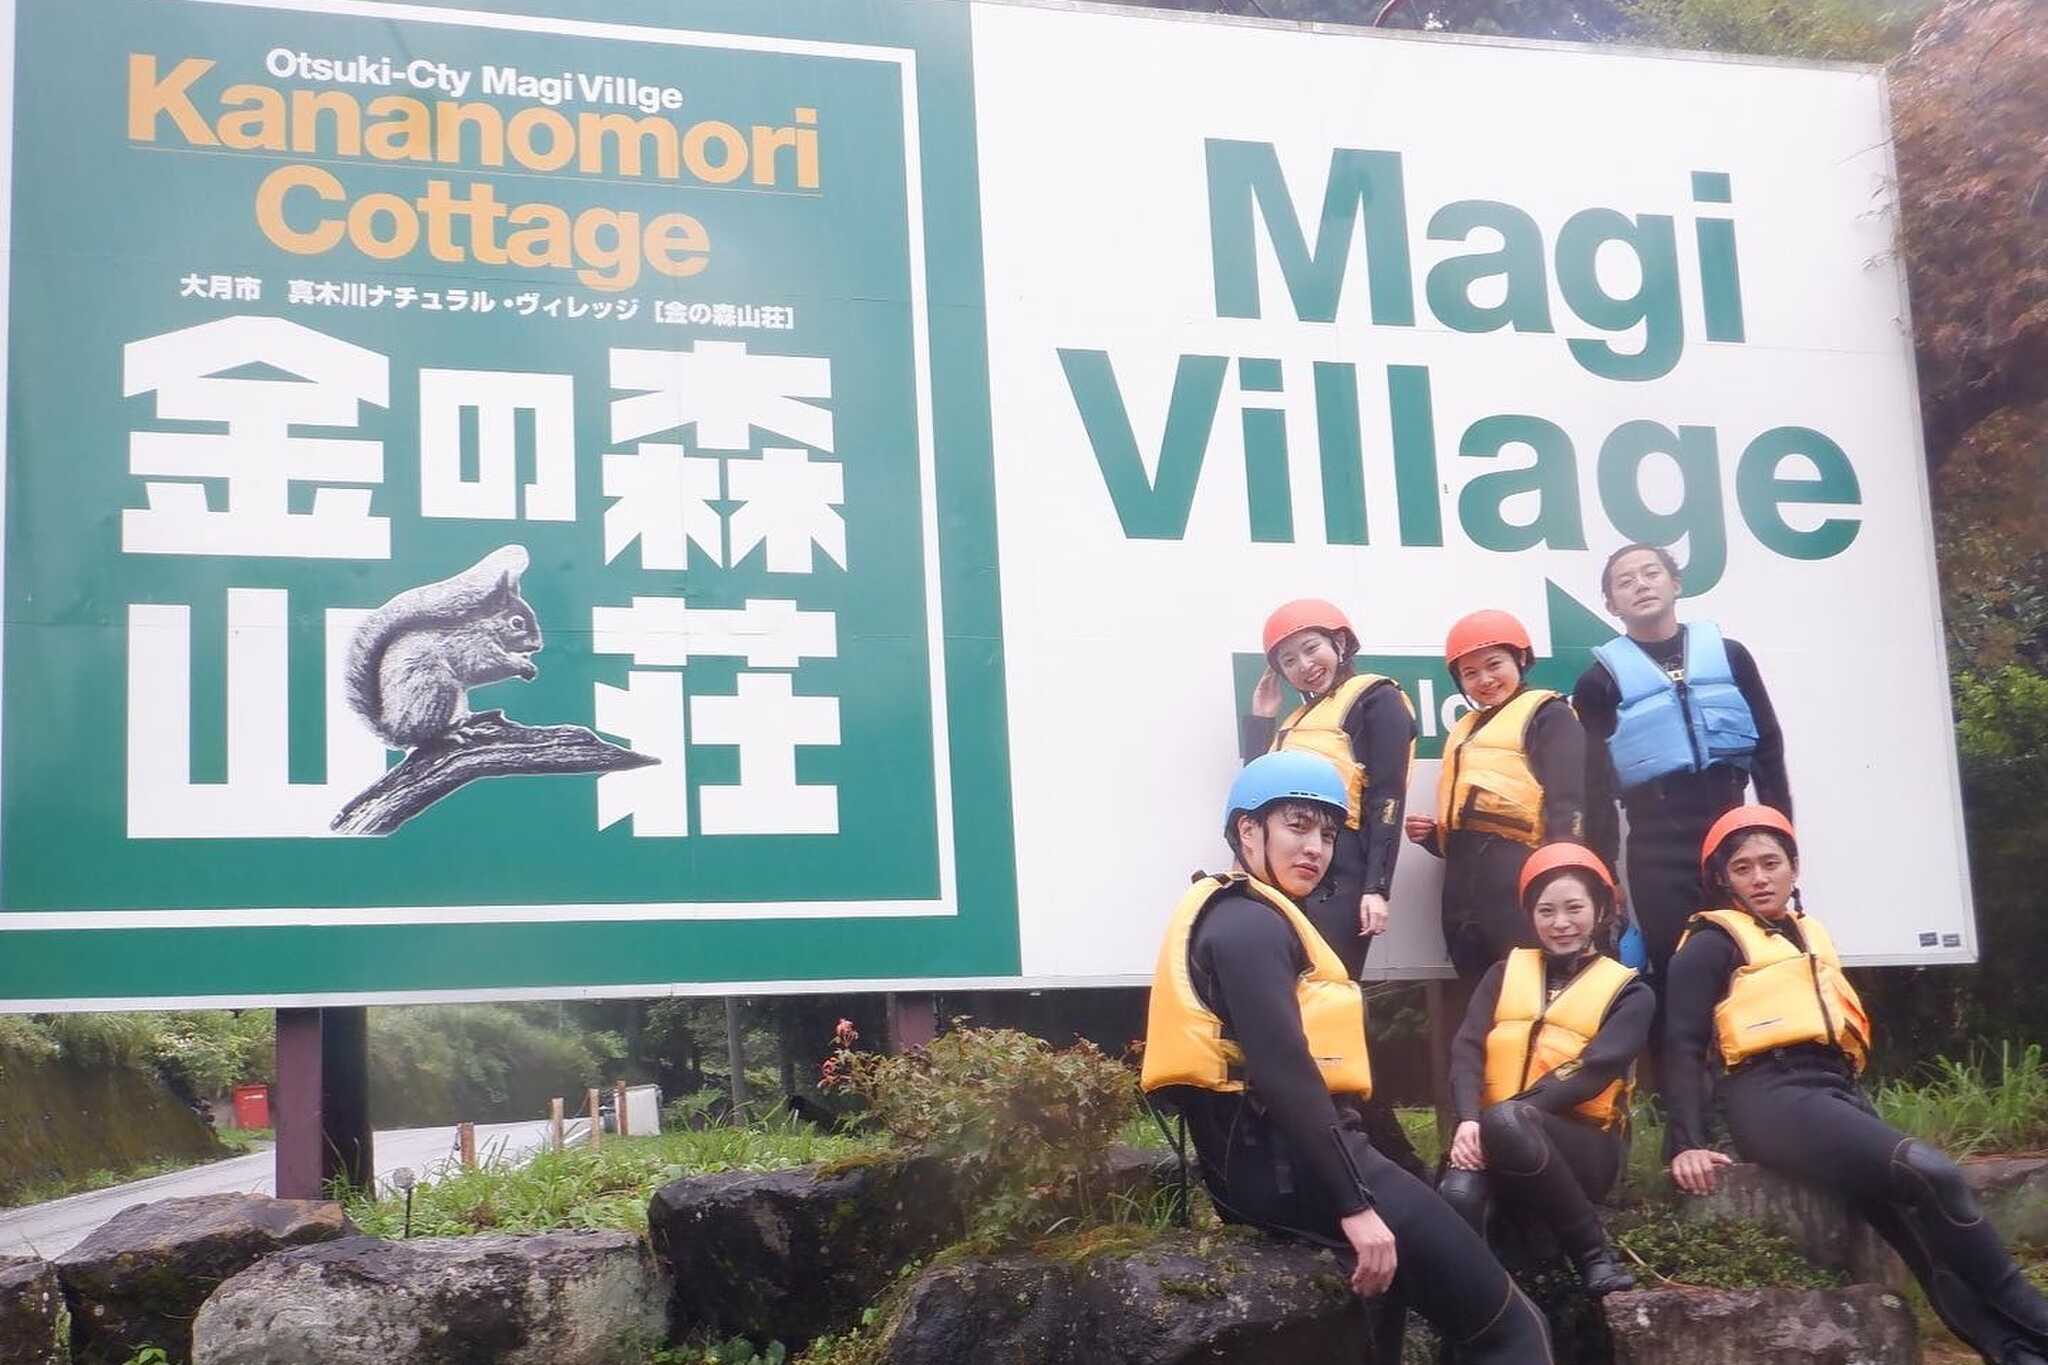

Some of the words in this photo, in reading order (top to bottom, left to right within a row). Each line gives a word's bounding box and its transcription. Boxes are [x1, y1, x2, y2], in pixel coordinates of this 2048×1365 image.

[127, 53, 820, 188] Kananomori
[265, 47, 471, 98] Otsuki-Cty
[482, 64, 573, 106] Magi
[576, 72, 684, 114] Villge
[180, 272, 263, 301] 大月市
[255, 165, 711, 291] Cottage
[1204, 137, 1747, 382] Magi
[122, 315, 848, 574] 金の森
[1055, 347, 1864, 601] Village
[126, 587, 842, 838] 山荘
